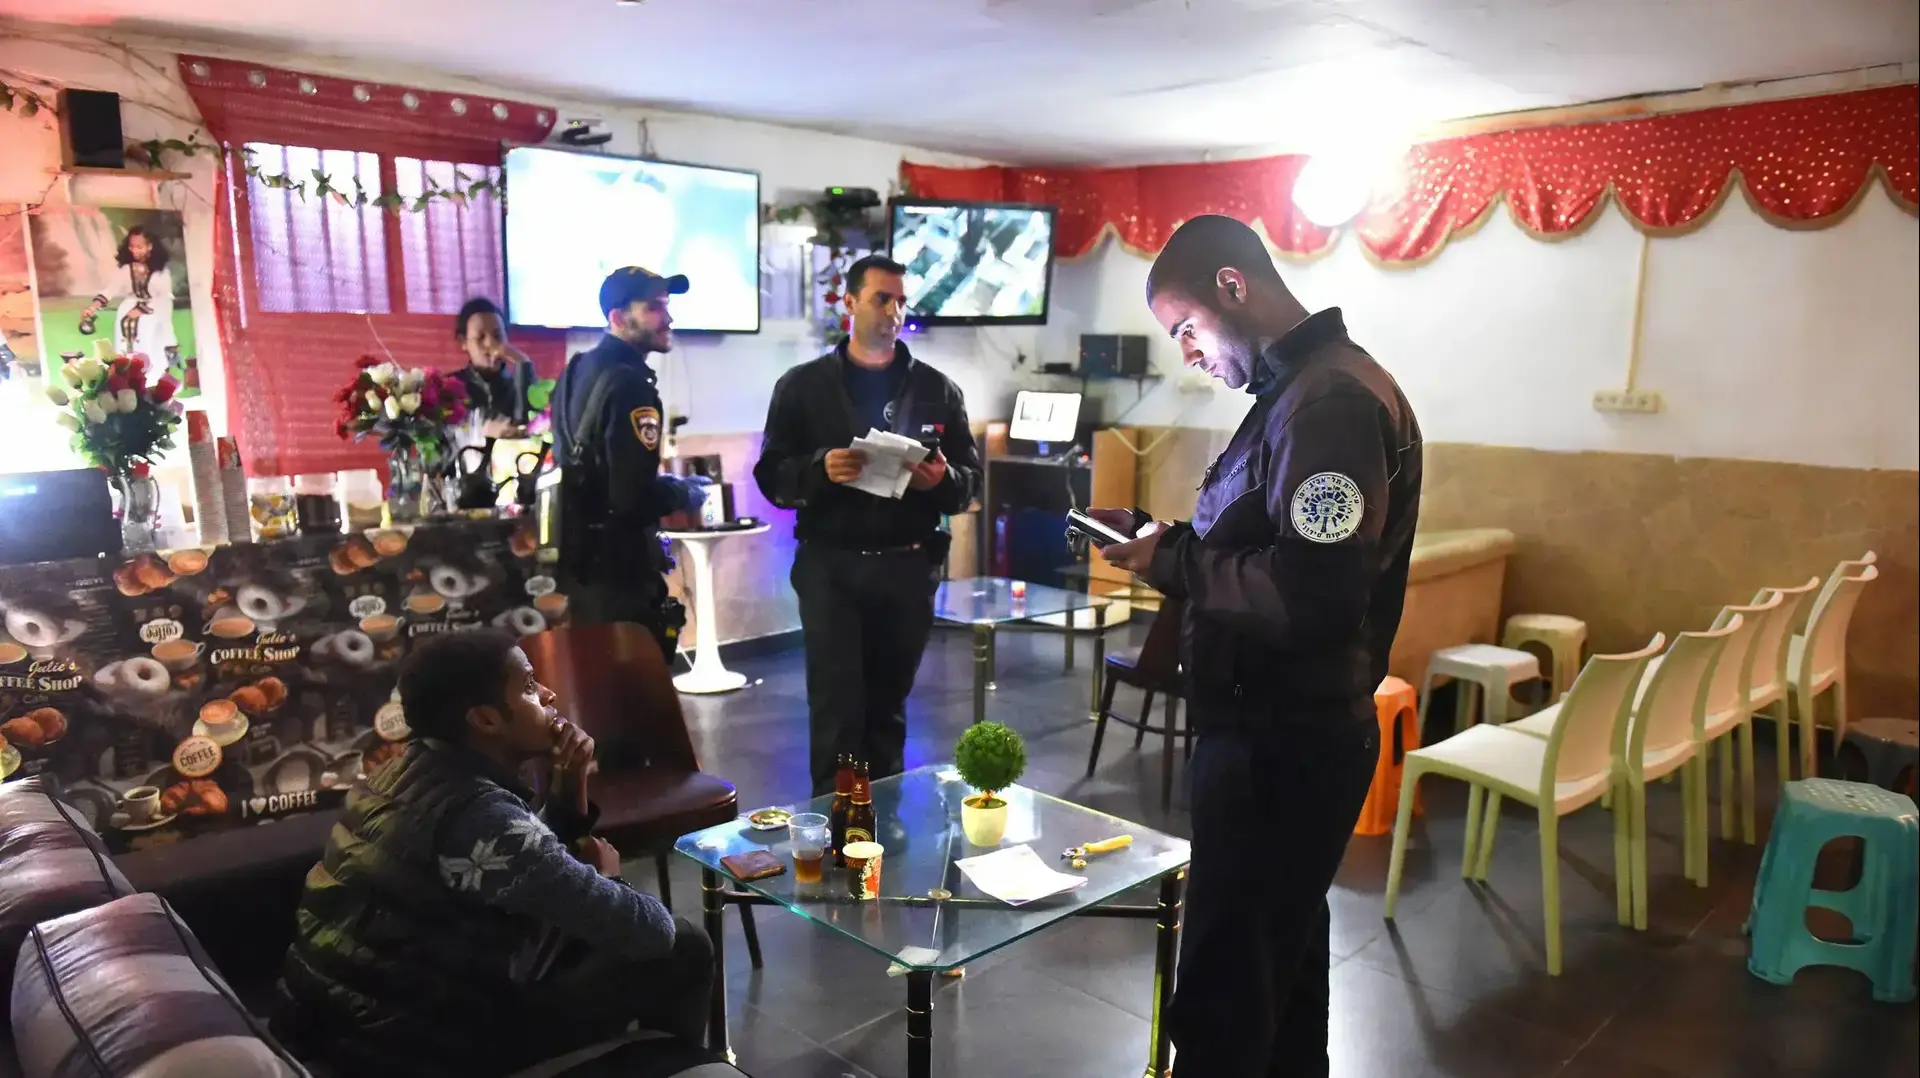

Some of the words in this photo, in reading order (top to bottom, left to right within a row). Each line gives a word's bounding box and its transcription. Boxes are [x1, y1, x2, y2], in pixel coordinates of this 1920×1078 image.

[210, 648, 262, 664] COFFEE
[28, 657, 77, 679] Julie's
[38, 675, 83, 692] SHOP
[179, 746, 216, 767] COFFEE
[268, 789, 318, 813] COFFEE
